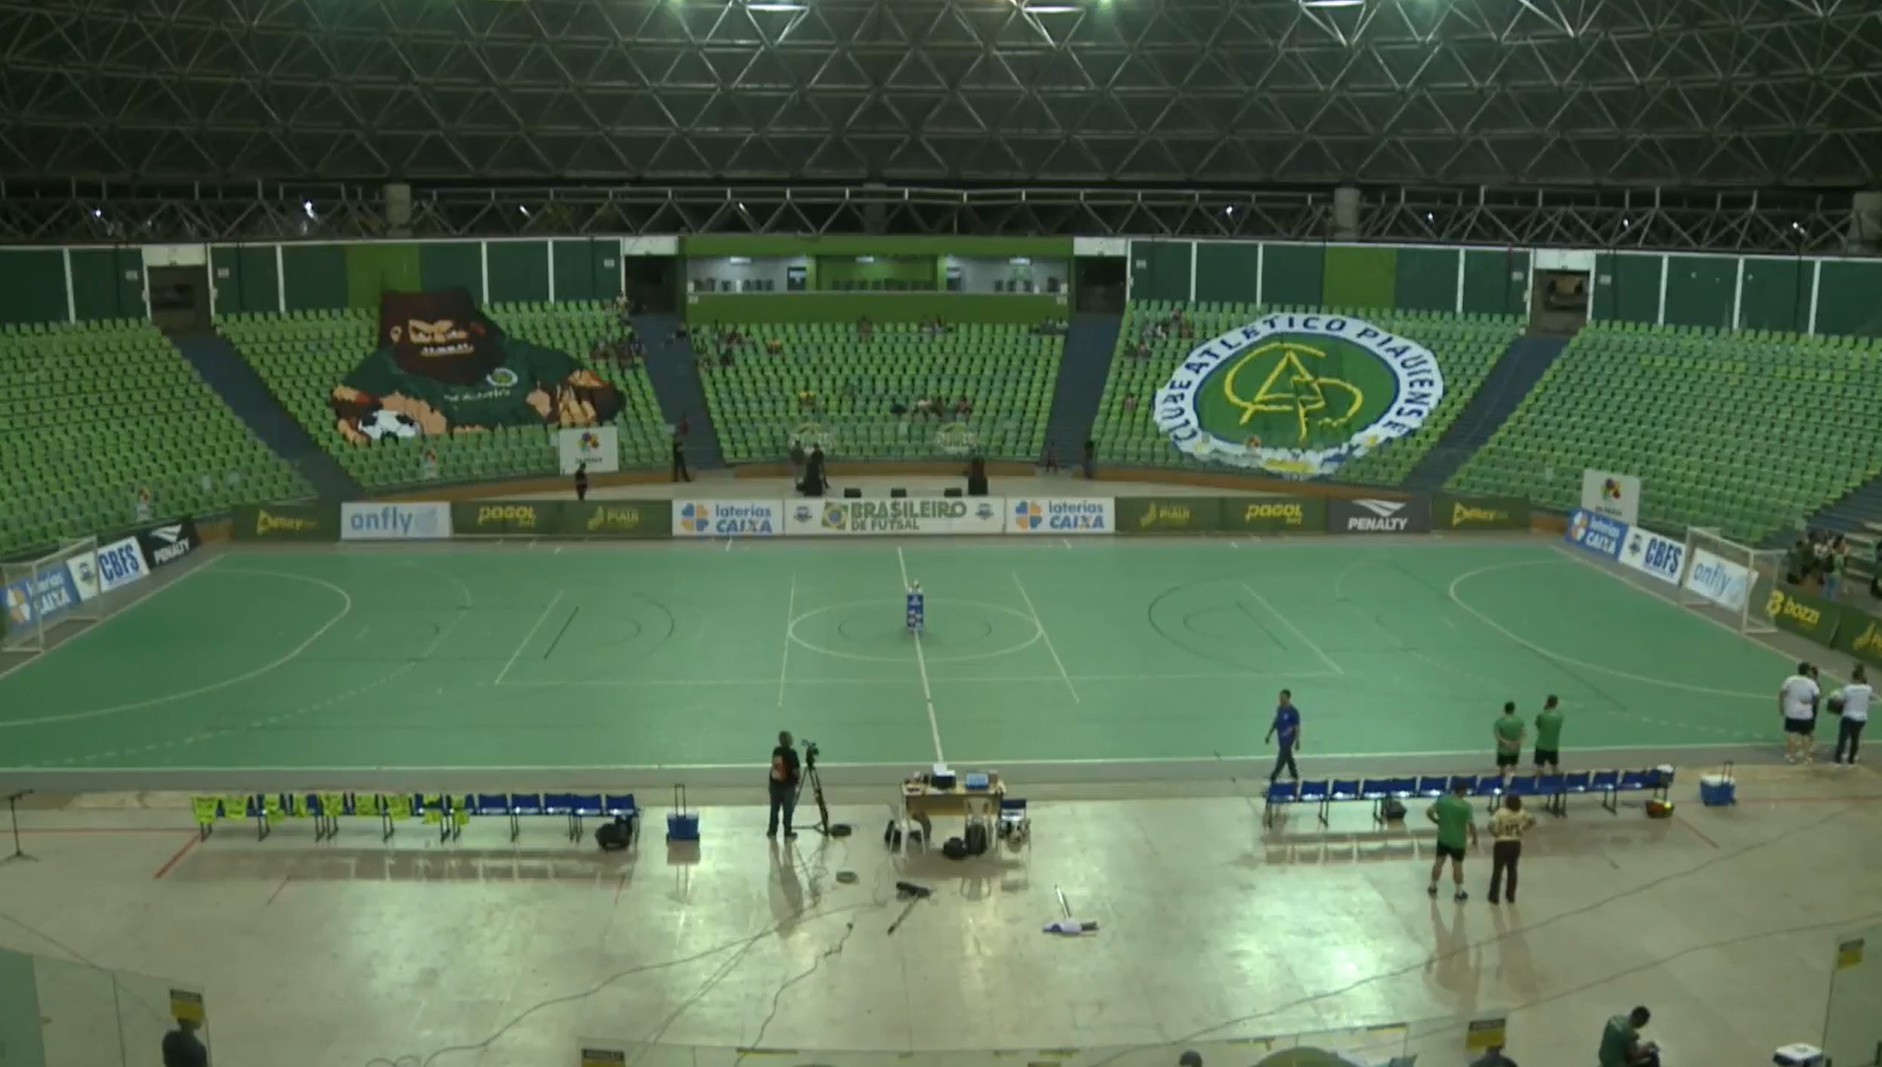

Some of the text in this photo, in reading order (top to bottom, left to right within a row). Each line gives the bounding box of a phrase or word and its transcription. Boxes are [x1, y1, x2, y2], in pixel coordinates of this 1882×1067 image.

[1160, 379, 1198, 441] CLUBE
[850, 499, 967, 518] BRASILEIRO
[715, 518, 772, 533] CAIXA
[851, 518, 920, 531] DE FUTSAL
[1049, 514, 1105, 529] CAIXA
[1347, 517, 1408, 531] PENALTY
[98, 544, 139, 582] CBFS
[1645, 537, 1682, 573] CBFS
